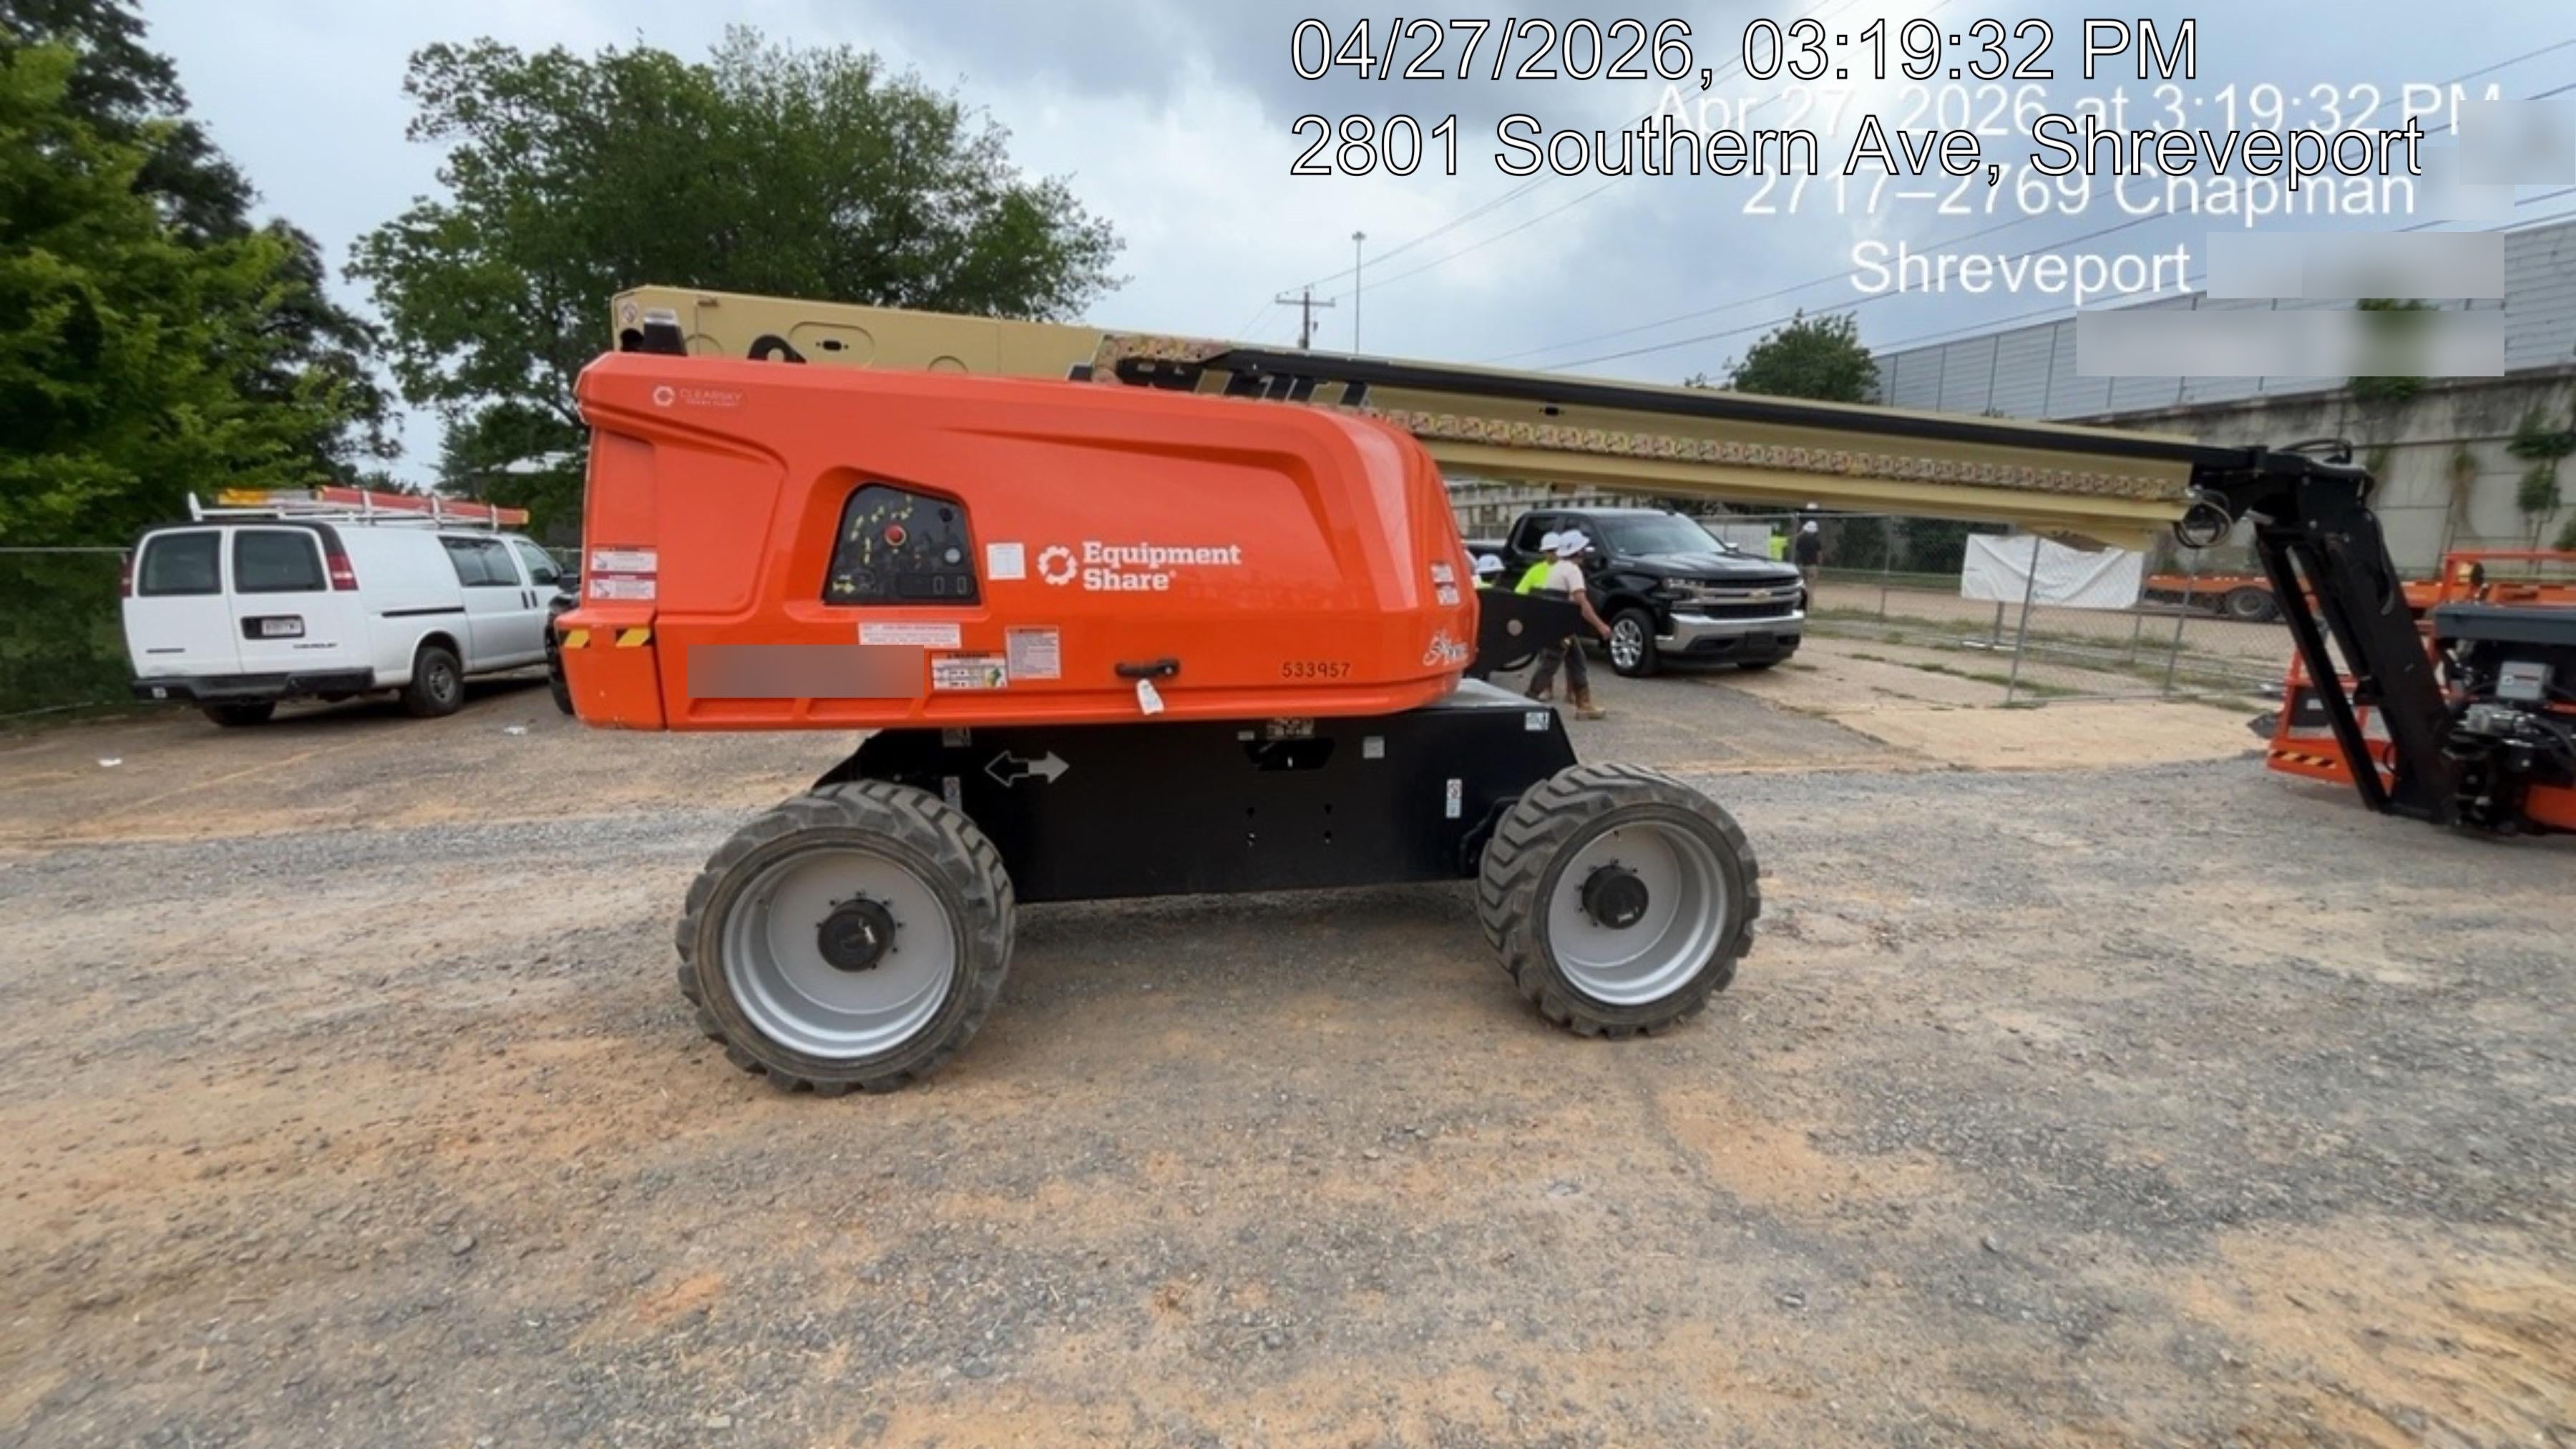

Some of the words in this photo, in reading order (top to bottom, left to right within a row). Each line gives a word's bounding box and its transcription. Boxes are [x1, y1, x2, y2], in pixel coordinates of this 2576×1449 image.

[1082, 540, 1242, 569] Equipment
[1082, 567, 1170, 591] Share
[1282, 661, 1351, 678] 533957
